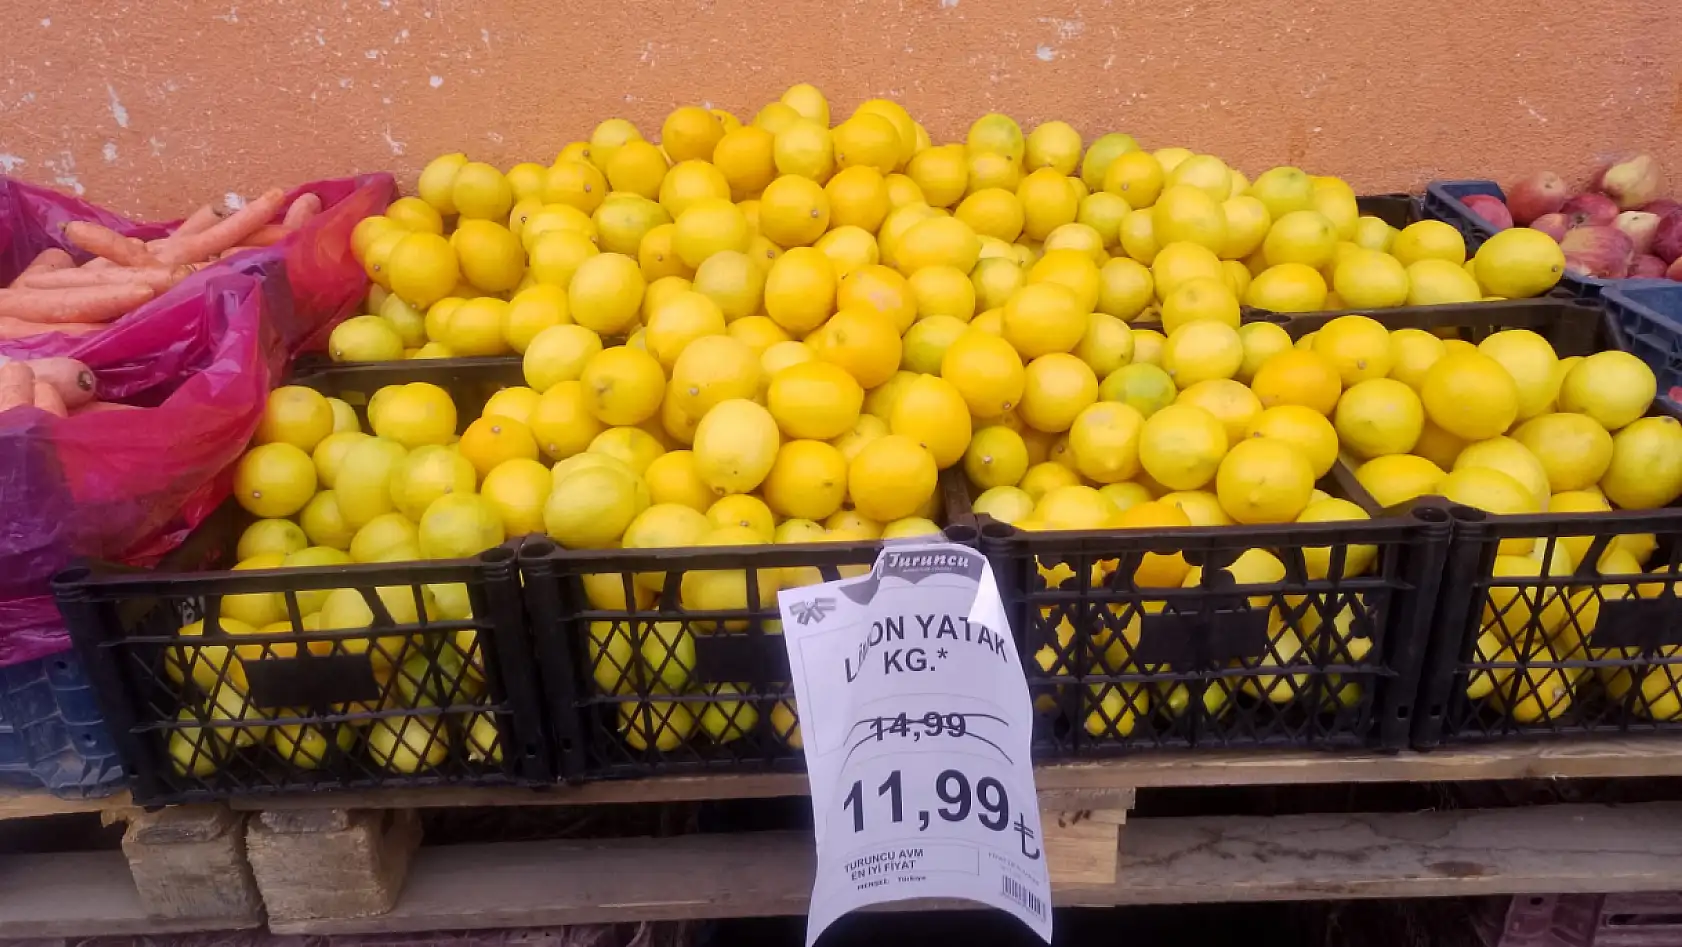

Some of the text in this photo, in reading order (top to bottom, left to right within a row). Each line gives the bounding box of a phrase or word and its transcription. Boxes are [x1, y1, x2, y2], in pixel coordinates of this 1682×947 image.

[889, 553, 969, 568] Turuncu
[844, 613, 1008, 683] LİON YATAK
[869, 711, 967, 742] 14,99
[844, 848, 924, 873] TURUNCU AVM
[851, 869, 866, 881] EN
